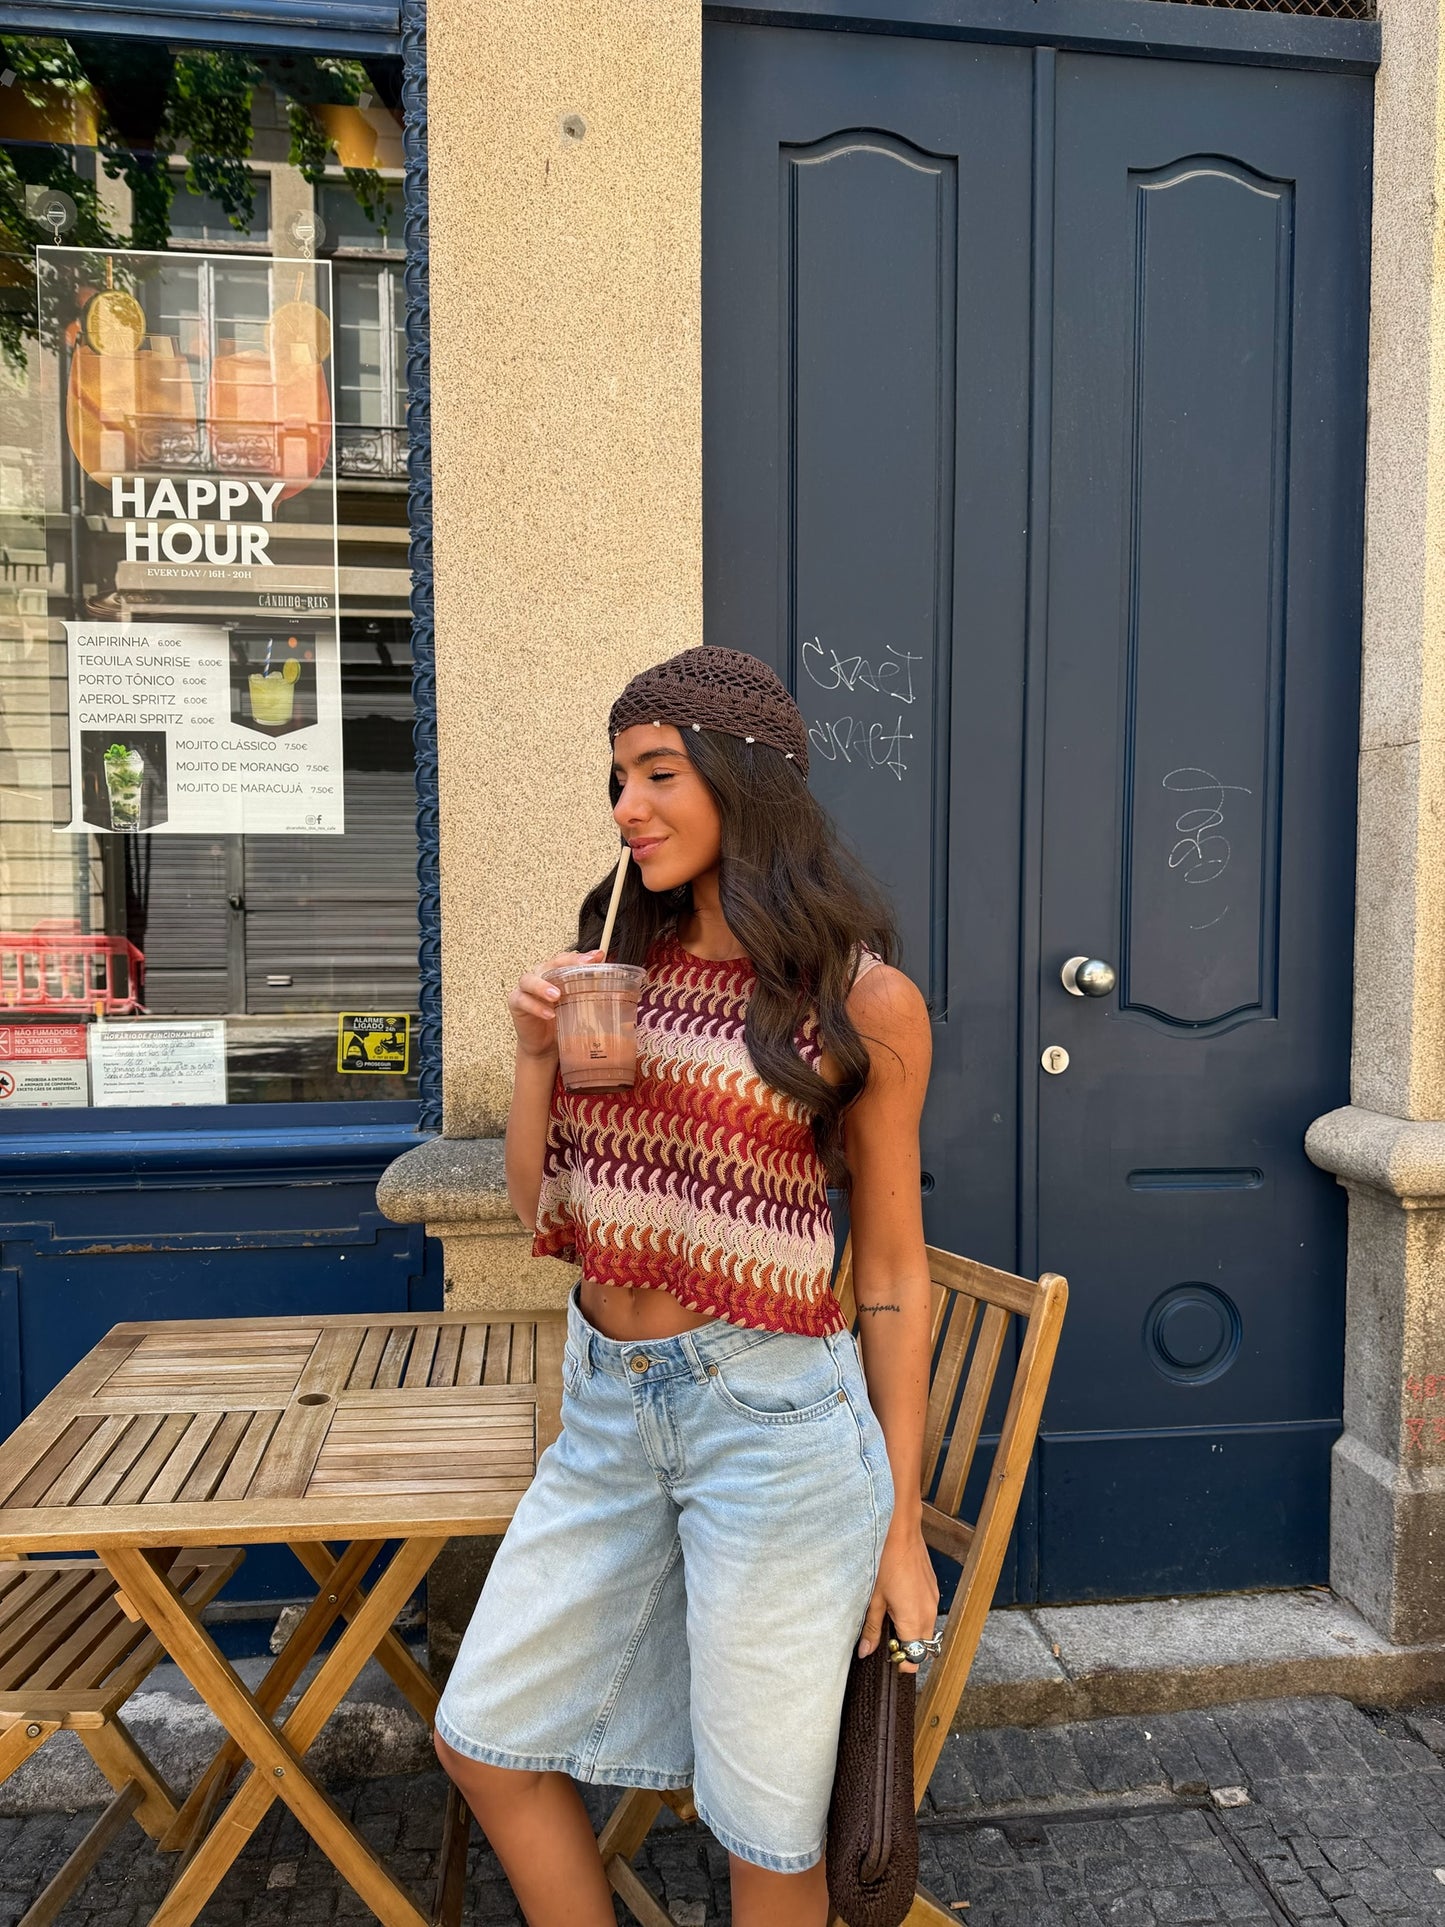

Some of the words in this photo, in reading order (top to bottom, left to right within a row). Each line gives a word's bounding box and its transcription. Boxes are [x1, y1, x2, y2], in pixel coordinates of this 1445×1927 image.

[111, 476, 286, 522] HAPPY
[125, 521, 275, 566] HOUR
[147, 568, 179, 577] EVERY
[181, 569, 201, 577] DAY
[208, 570, 225, 578] 16H
[232, 570, 252, 579] 20H
[307, 595, 329, 609] REIS
[77, 635, 150, 647] CAIPIRINHA
[157, 639, 182, 647] 6.00€
[78, 655, 133, 667] TEQUILA
[135, 656, 191, 668] SUNRISE
[198, 659, 223, 667] 6.00€
[78, 674, 122, 685] PORTO
[125, 672, 175, 686] TÔNICO
[182, 677, 207, 685] 6.00€
[78, 693, 130, 705] APEROL
[132, 694, 176, 705] SPRITZ
[183, 697, 208, 705] 6.00€
[78, 712, 136, 724] CAMPARI
[139, 713, 183, 725] SPRITZ
[190, 717, 215, 725] 6.00€
[175, 740, 218, 750] MOJITO
[220, 739, 277, 751] CLÁSSICO
[176, 761, 219, 772] MOJITO
[221, 762, 237, 772] DE
[240, 762, 299, 772] MORANGO
[306, 764, 330, 772] 7.50€
[176, 783, 220, 793] MOJITO
[222, 783, 238, 793] DE
[240, 782, 304, 794] MARACUJÁ
[310, 786, 334, 794] 7.50€
[15, 1028, 31, 1036] NÃO
